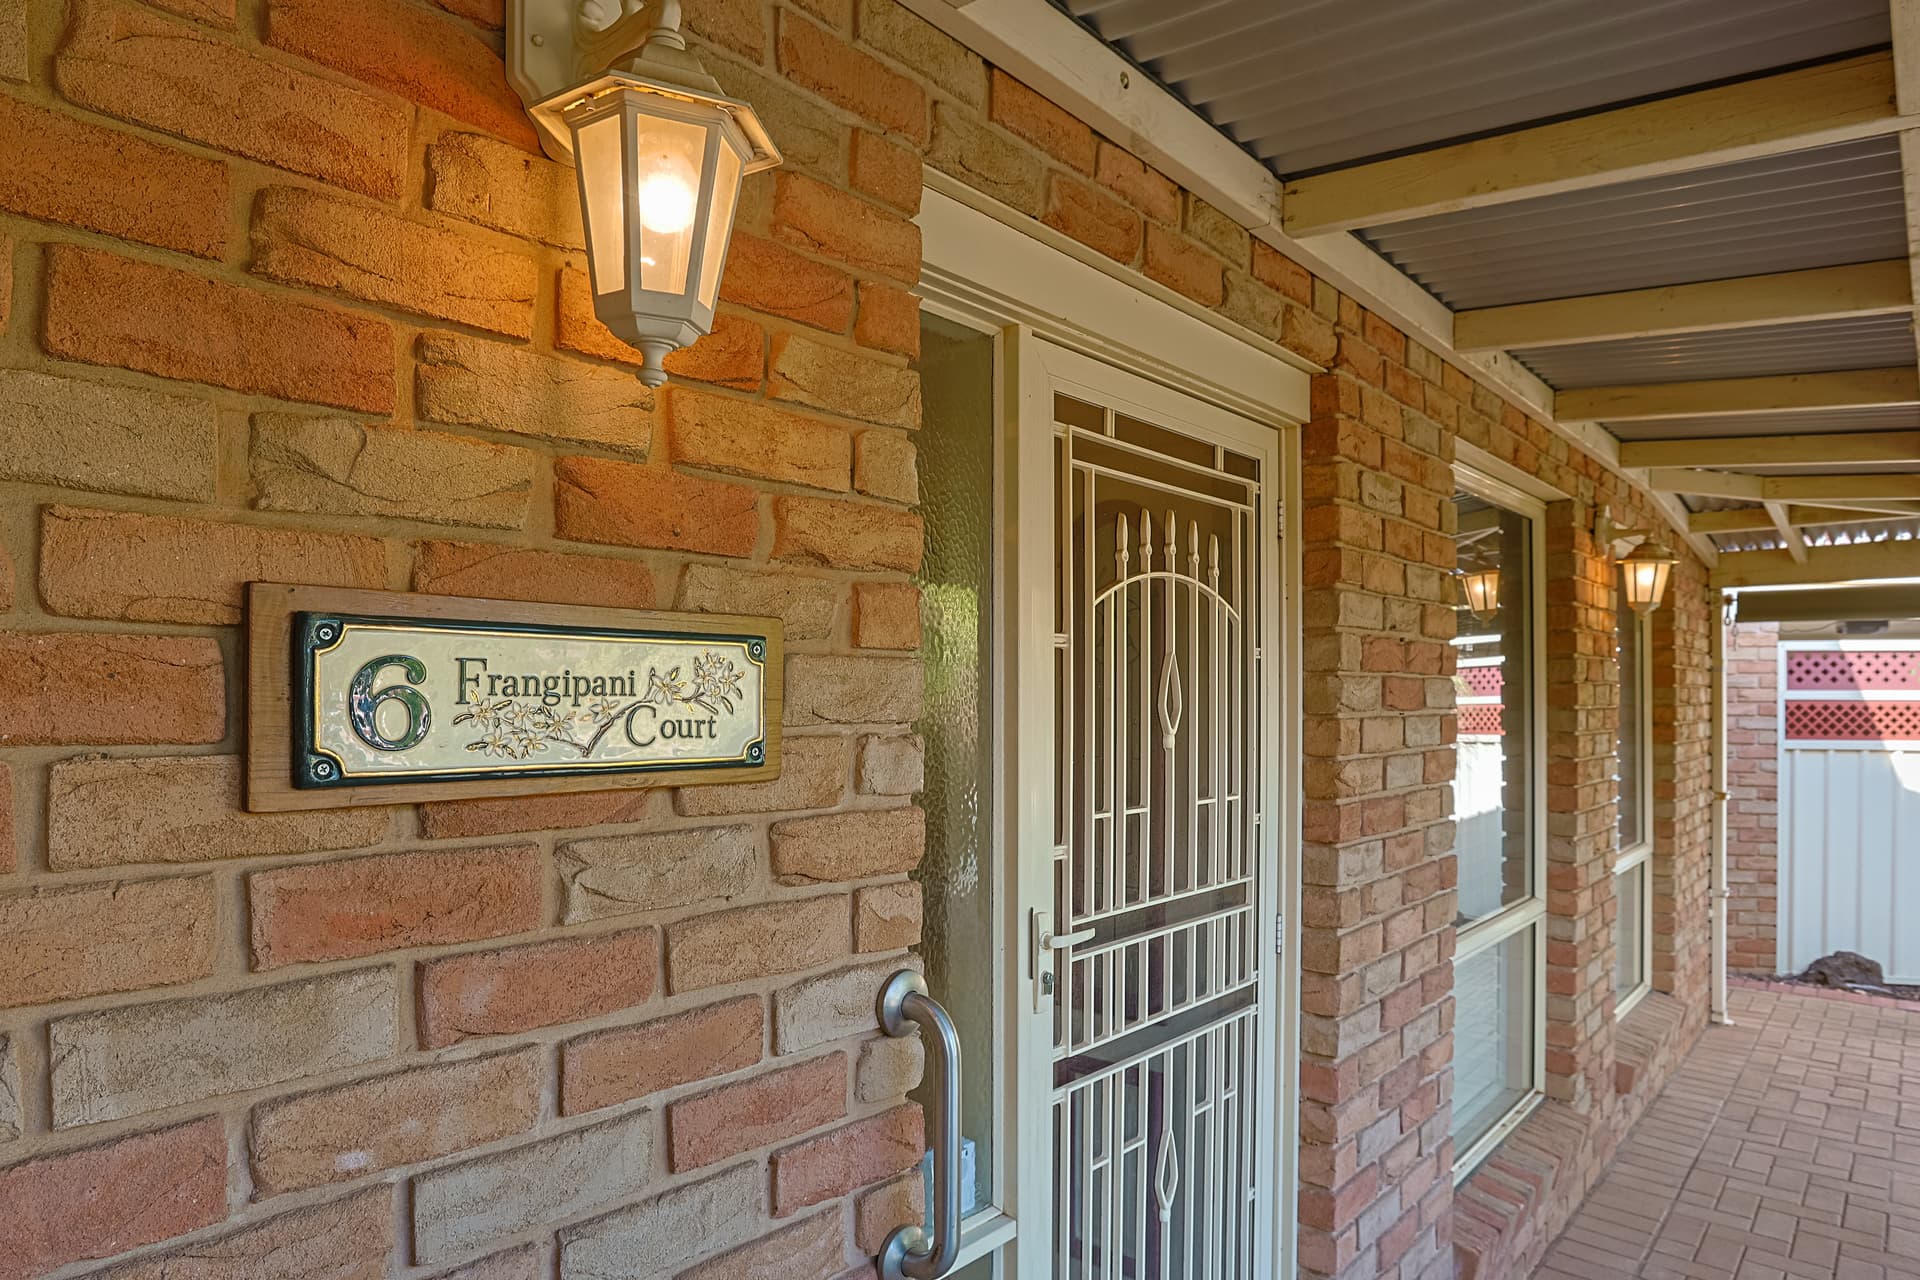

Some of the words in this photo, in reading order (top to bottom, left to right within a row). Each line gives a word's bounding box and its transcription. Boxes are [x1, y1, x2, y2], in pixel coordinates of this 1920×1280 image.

[349, 654, 432, 751] 6
[454, 657, 637, 706] Frangipani
[625, 706, 717, 747] Court
